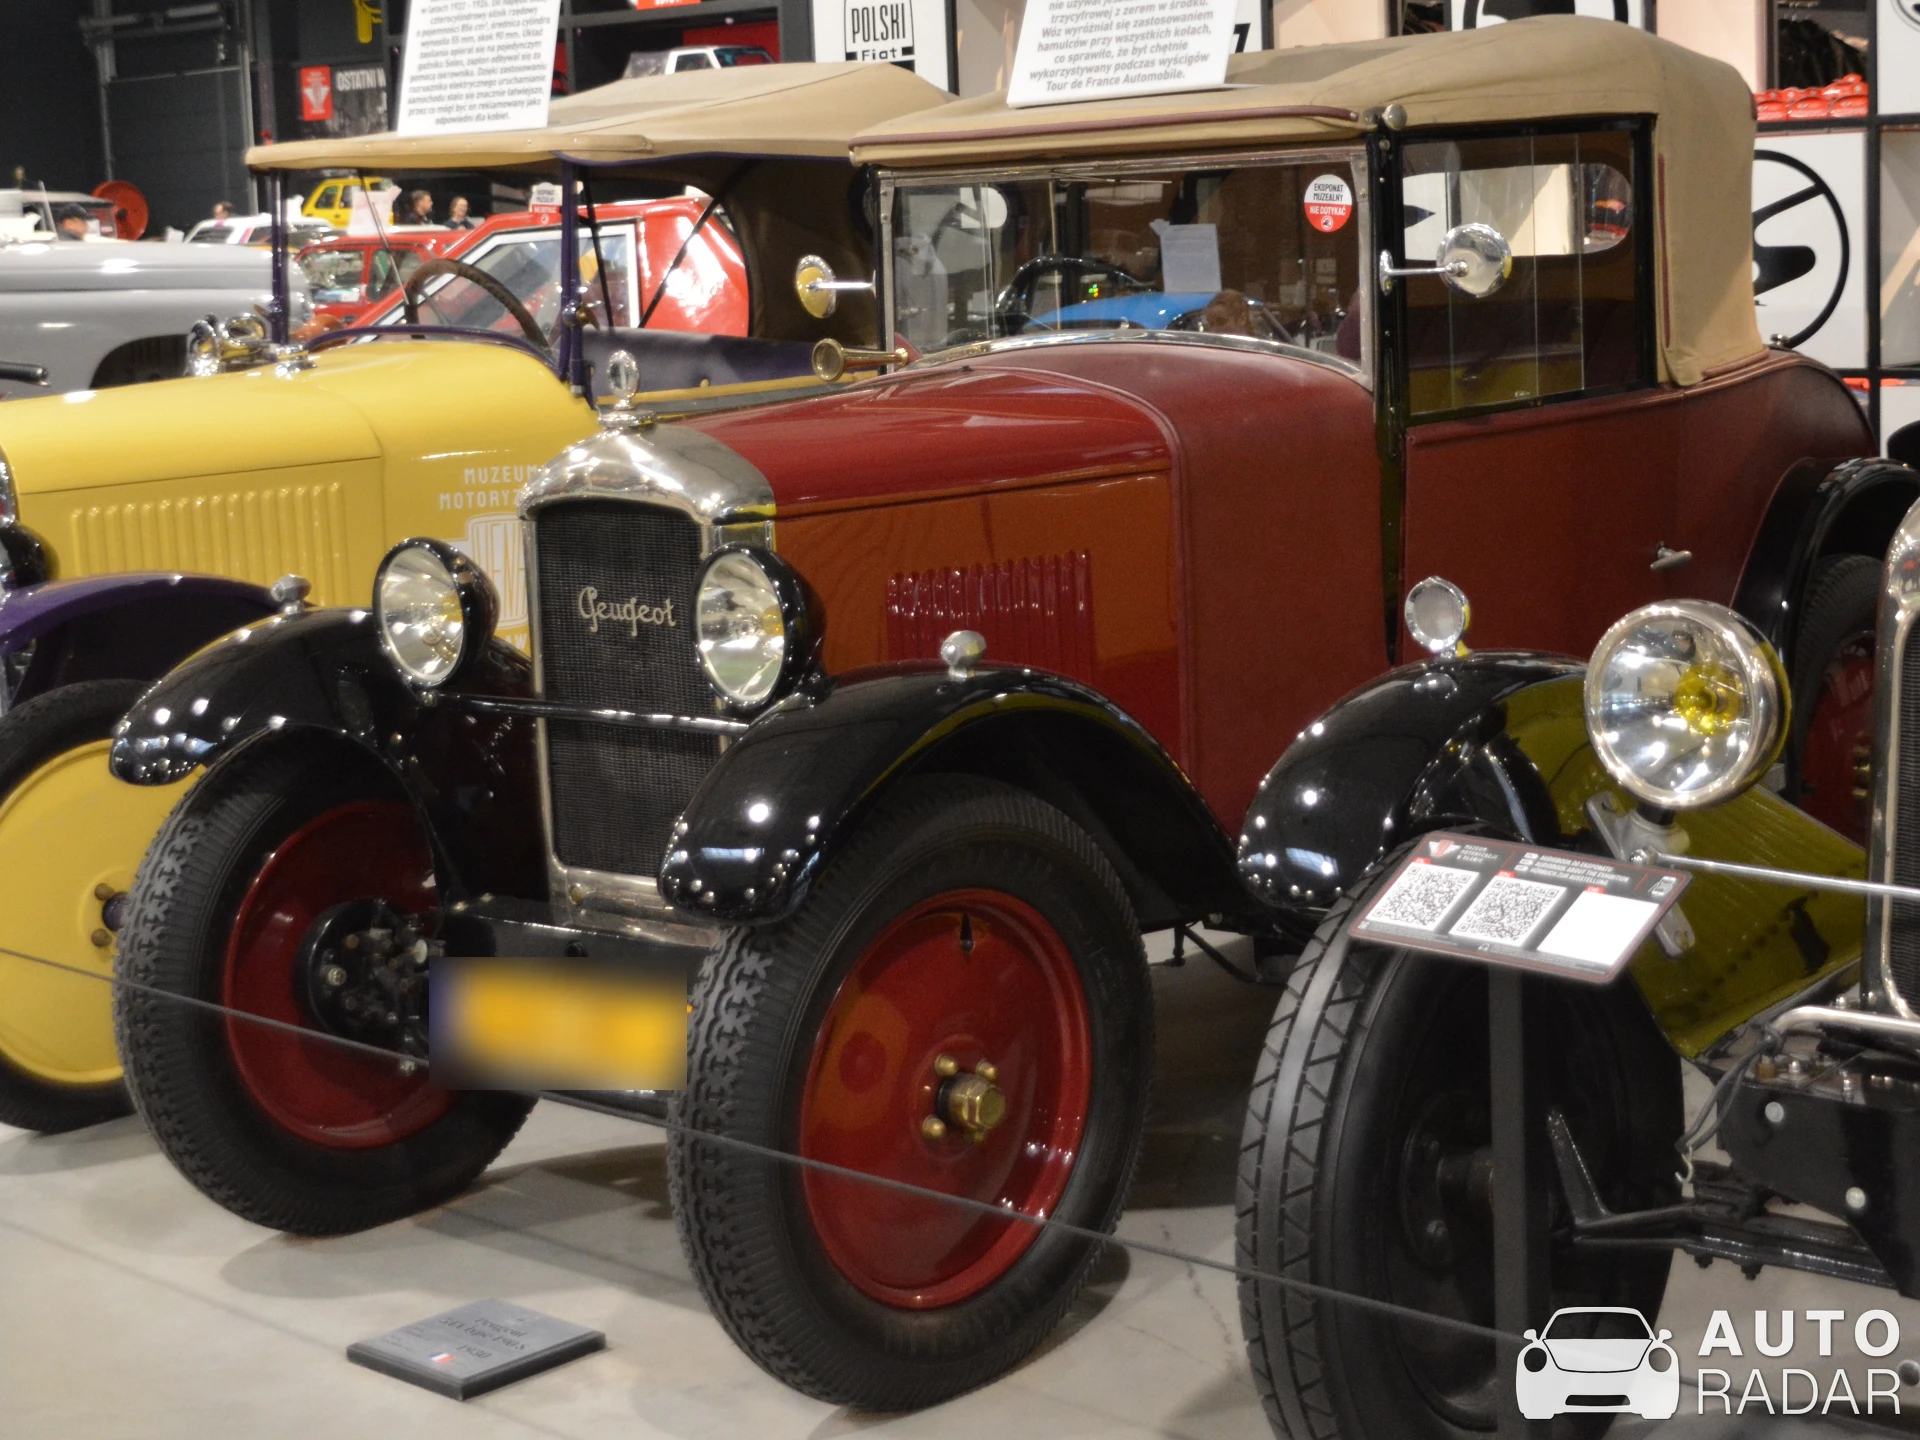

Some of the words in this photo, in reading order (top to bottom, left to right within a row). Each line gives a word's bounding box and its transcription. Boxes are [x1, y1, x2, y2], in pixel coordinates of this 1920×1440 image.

[1049, 1, 1064, 11] nie
[1051, 8, 1113, 24] trzycyfrowej
[1114, 8, 1121, 16] z
[1122, 4, 1155, 15] zerem
[1158, 3, 1167, 11] w
[851, 3, 905, 44] POLSKI
[1042, 26, 1062, 38] Wóz
[1064, 20, 1114, 36] wyróżniał
[1115, 18, 1130, 31] się
[1133, 10, 1214, 28] zastosowaniem
[1037, 36, 1088, 52] hamulców
[1090, 36, 1113, 49] przy
[1115, 28, 1171, 44] wszystkich
[1174, 24, 1212, 37] kołach,
[862, 47, 897, 61] Fiat
[1054, 55, 1065, 64] co
[1068, 49, 1114, 64] sprawiło,
[1117, 46, 1128, 57] że
[1131, 44, 1147, 57] był
[1150, 40, 1188, 54] chętnie
[1029, 62, 1112, 81] wykorzystywany
[1114, 58, 1156, 74] podczas
[1159, 51, 1210, 68] wyścigów
[335, 69, 377, 92] OSTATNI
[1046, 80, 1068, 91] Tour
[1071, 79, 1083, 89] de
[1085, 74, 1120, 88] France
[1122, 69, 1186, 84] Automobile.
[1313, 192, 1344, 202] MUZEALNY
[1314, 183, 1344, 193] EKSPONAT
[1309, 205, 1319, 215] NIE
[1320, 206, 1346, 216] DOTYKAĆ
[578, 586, 677, 637] Peugeot
